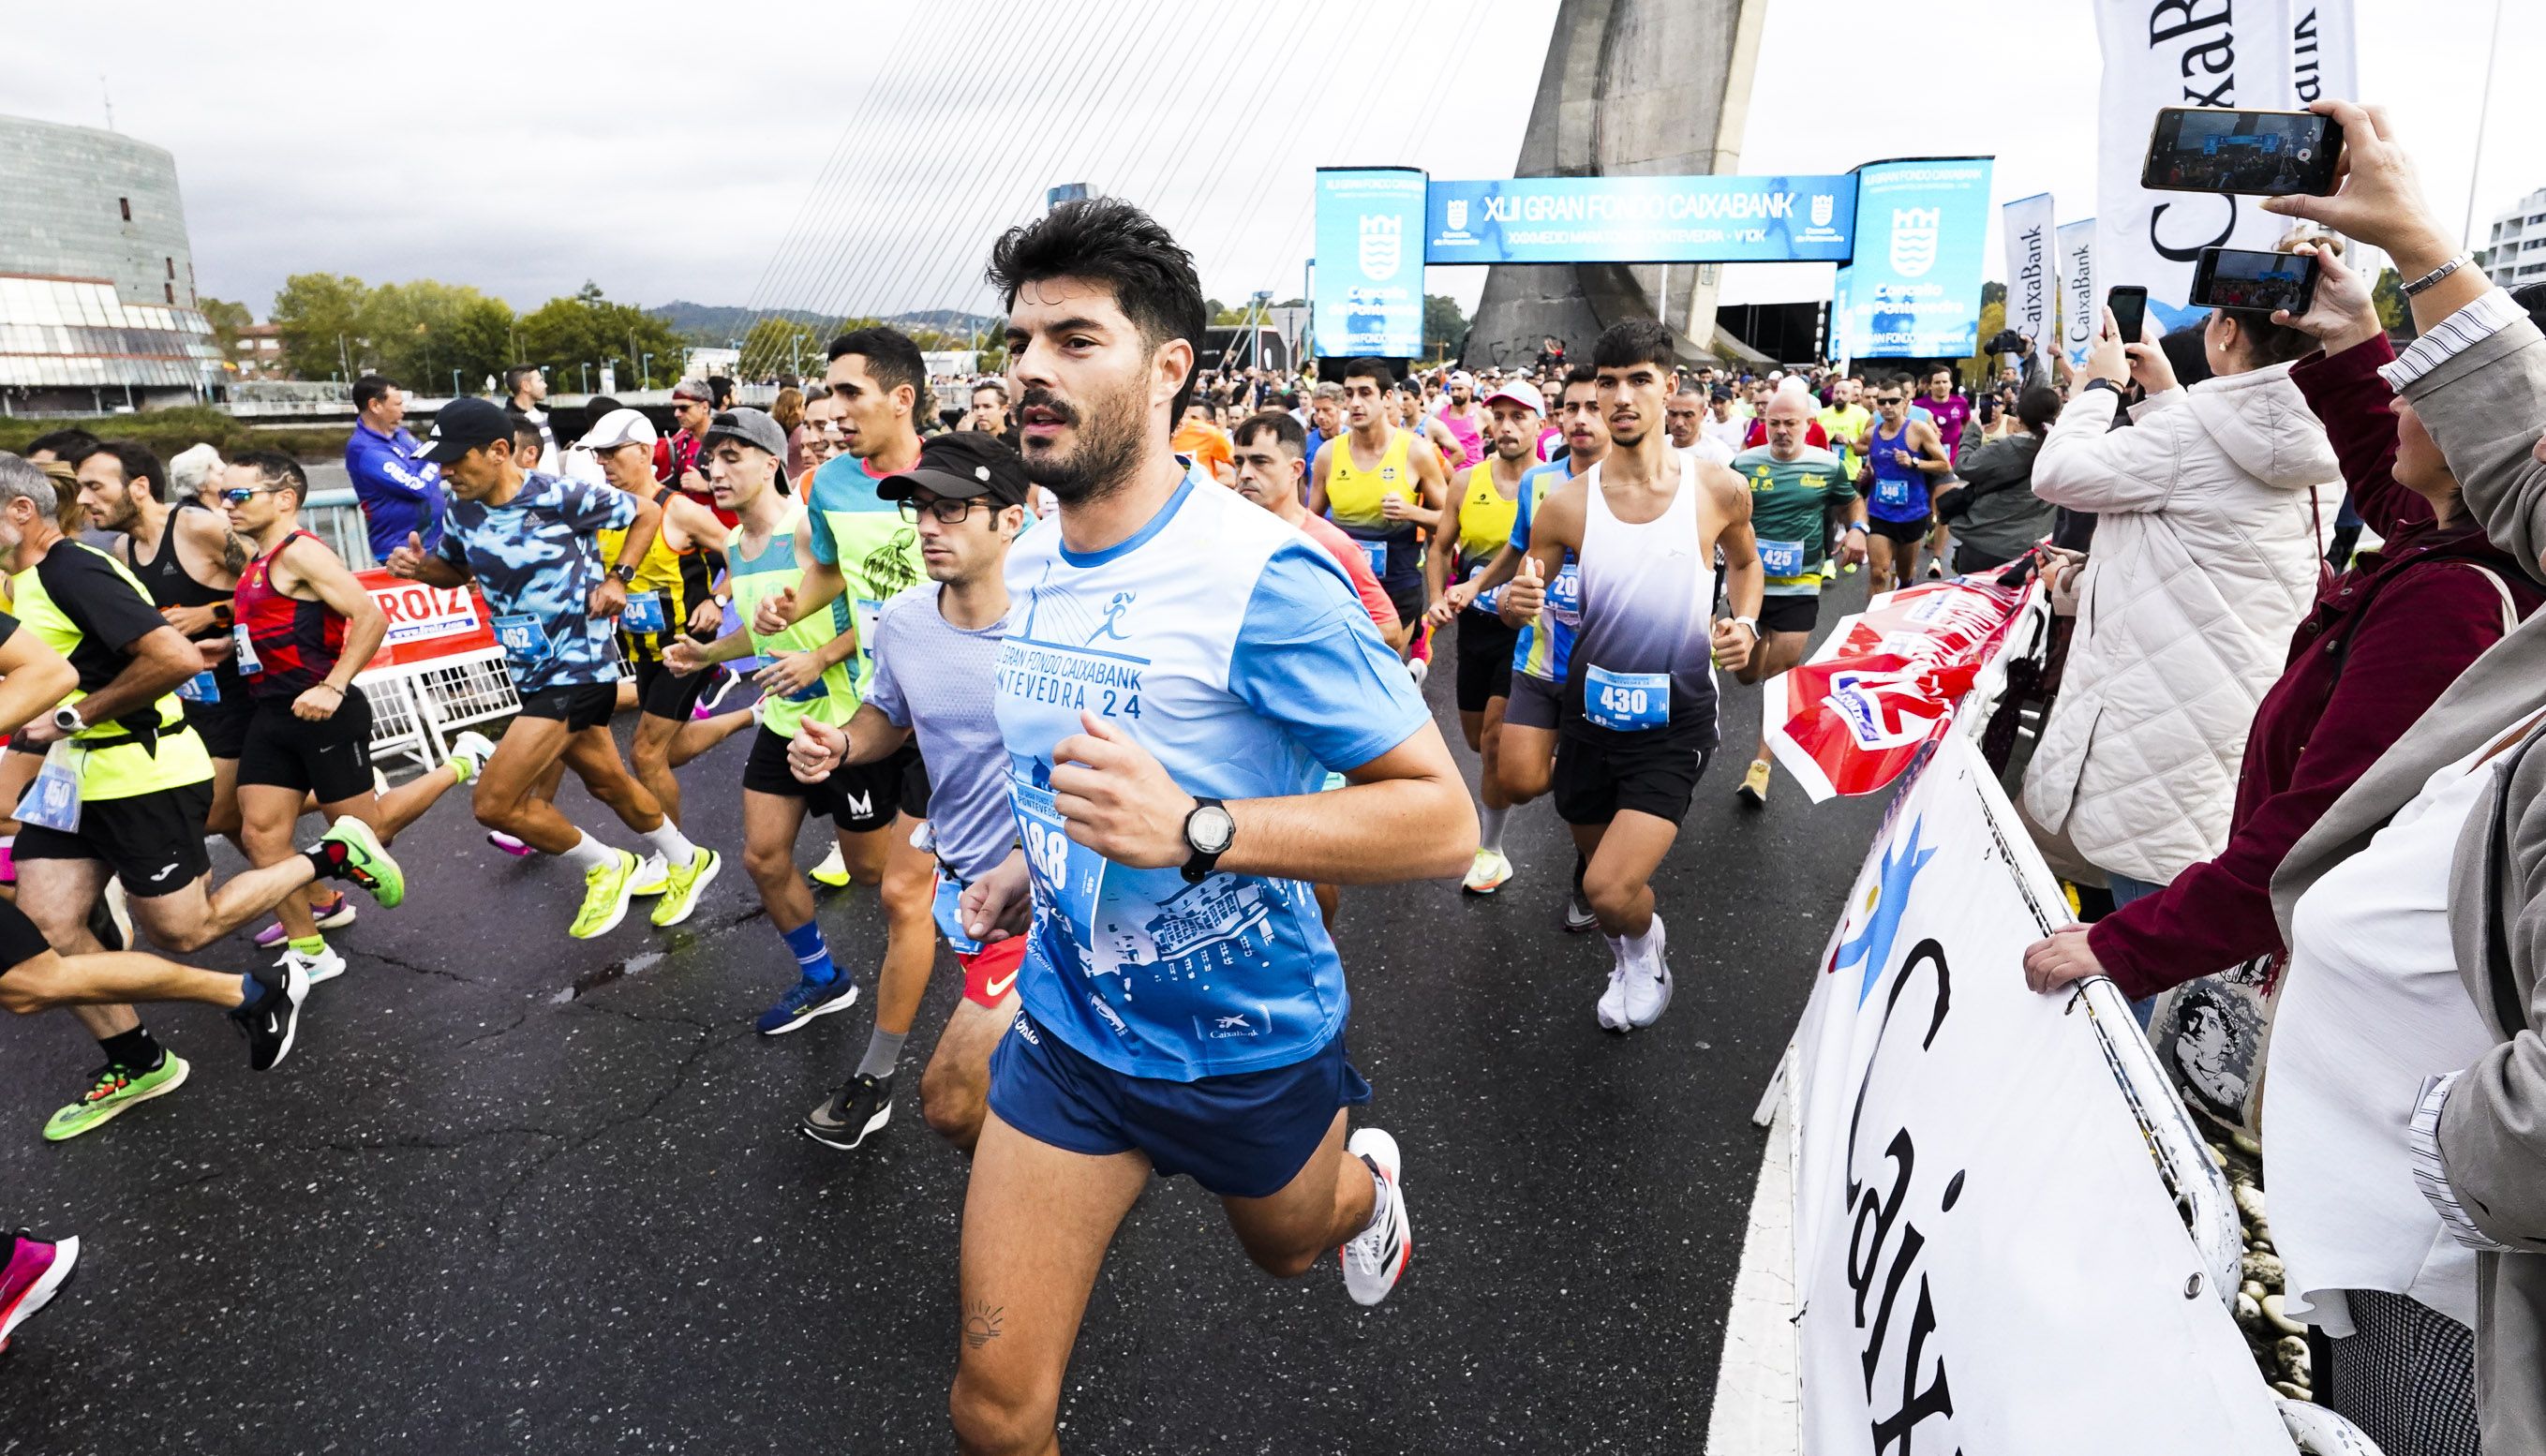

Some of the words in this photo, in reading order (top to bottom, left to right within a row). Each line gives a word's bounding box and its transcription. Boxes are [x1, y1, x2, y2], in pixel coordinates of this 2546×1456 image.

[1484, 195, 1520, 221] XLII
[1524, 195, 1585, 221] GRAN
[1586, 194, 1665, 221] FONDO
[1668, 191, 1795, 219] CAIXABANK
[2017, 225, 2042, 340] CaixaBank
[2071, 245, 2092, 342] CaixaBank
[1874, 301, 1964, 314] Pontevedra
[1763, 549, 1793, 567] 425
[371, 587, 468, 624] ROIZ
[1003, 646, 1028, 667] GRAN
[1029, 651, 1063, 676] FONDO
[1061, 657, 1142, 691] CAIXABANK
[1102, 690, 1141, 719] 24
[1601, 685, 1647, 715] 430
[1018, 795, 1062, 822] PONTEVEDRA
[1845, 937, 1966, 1456] Caix
